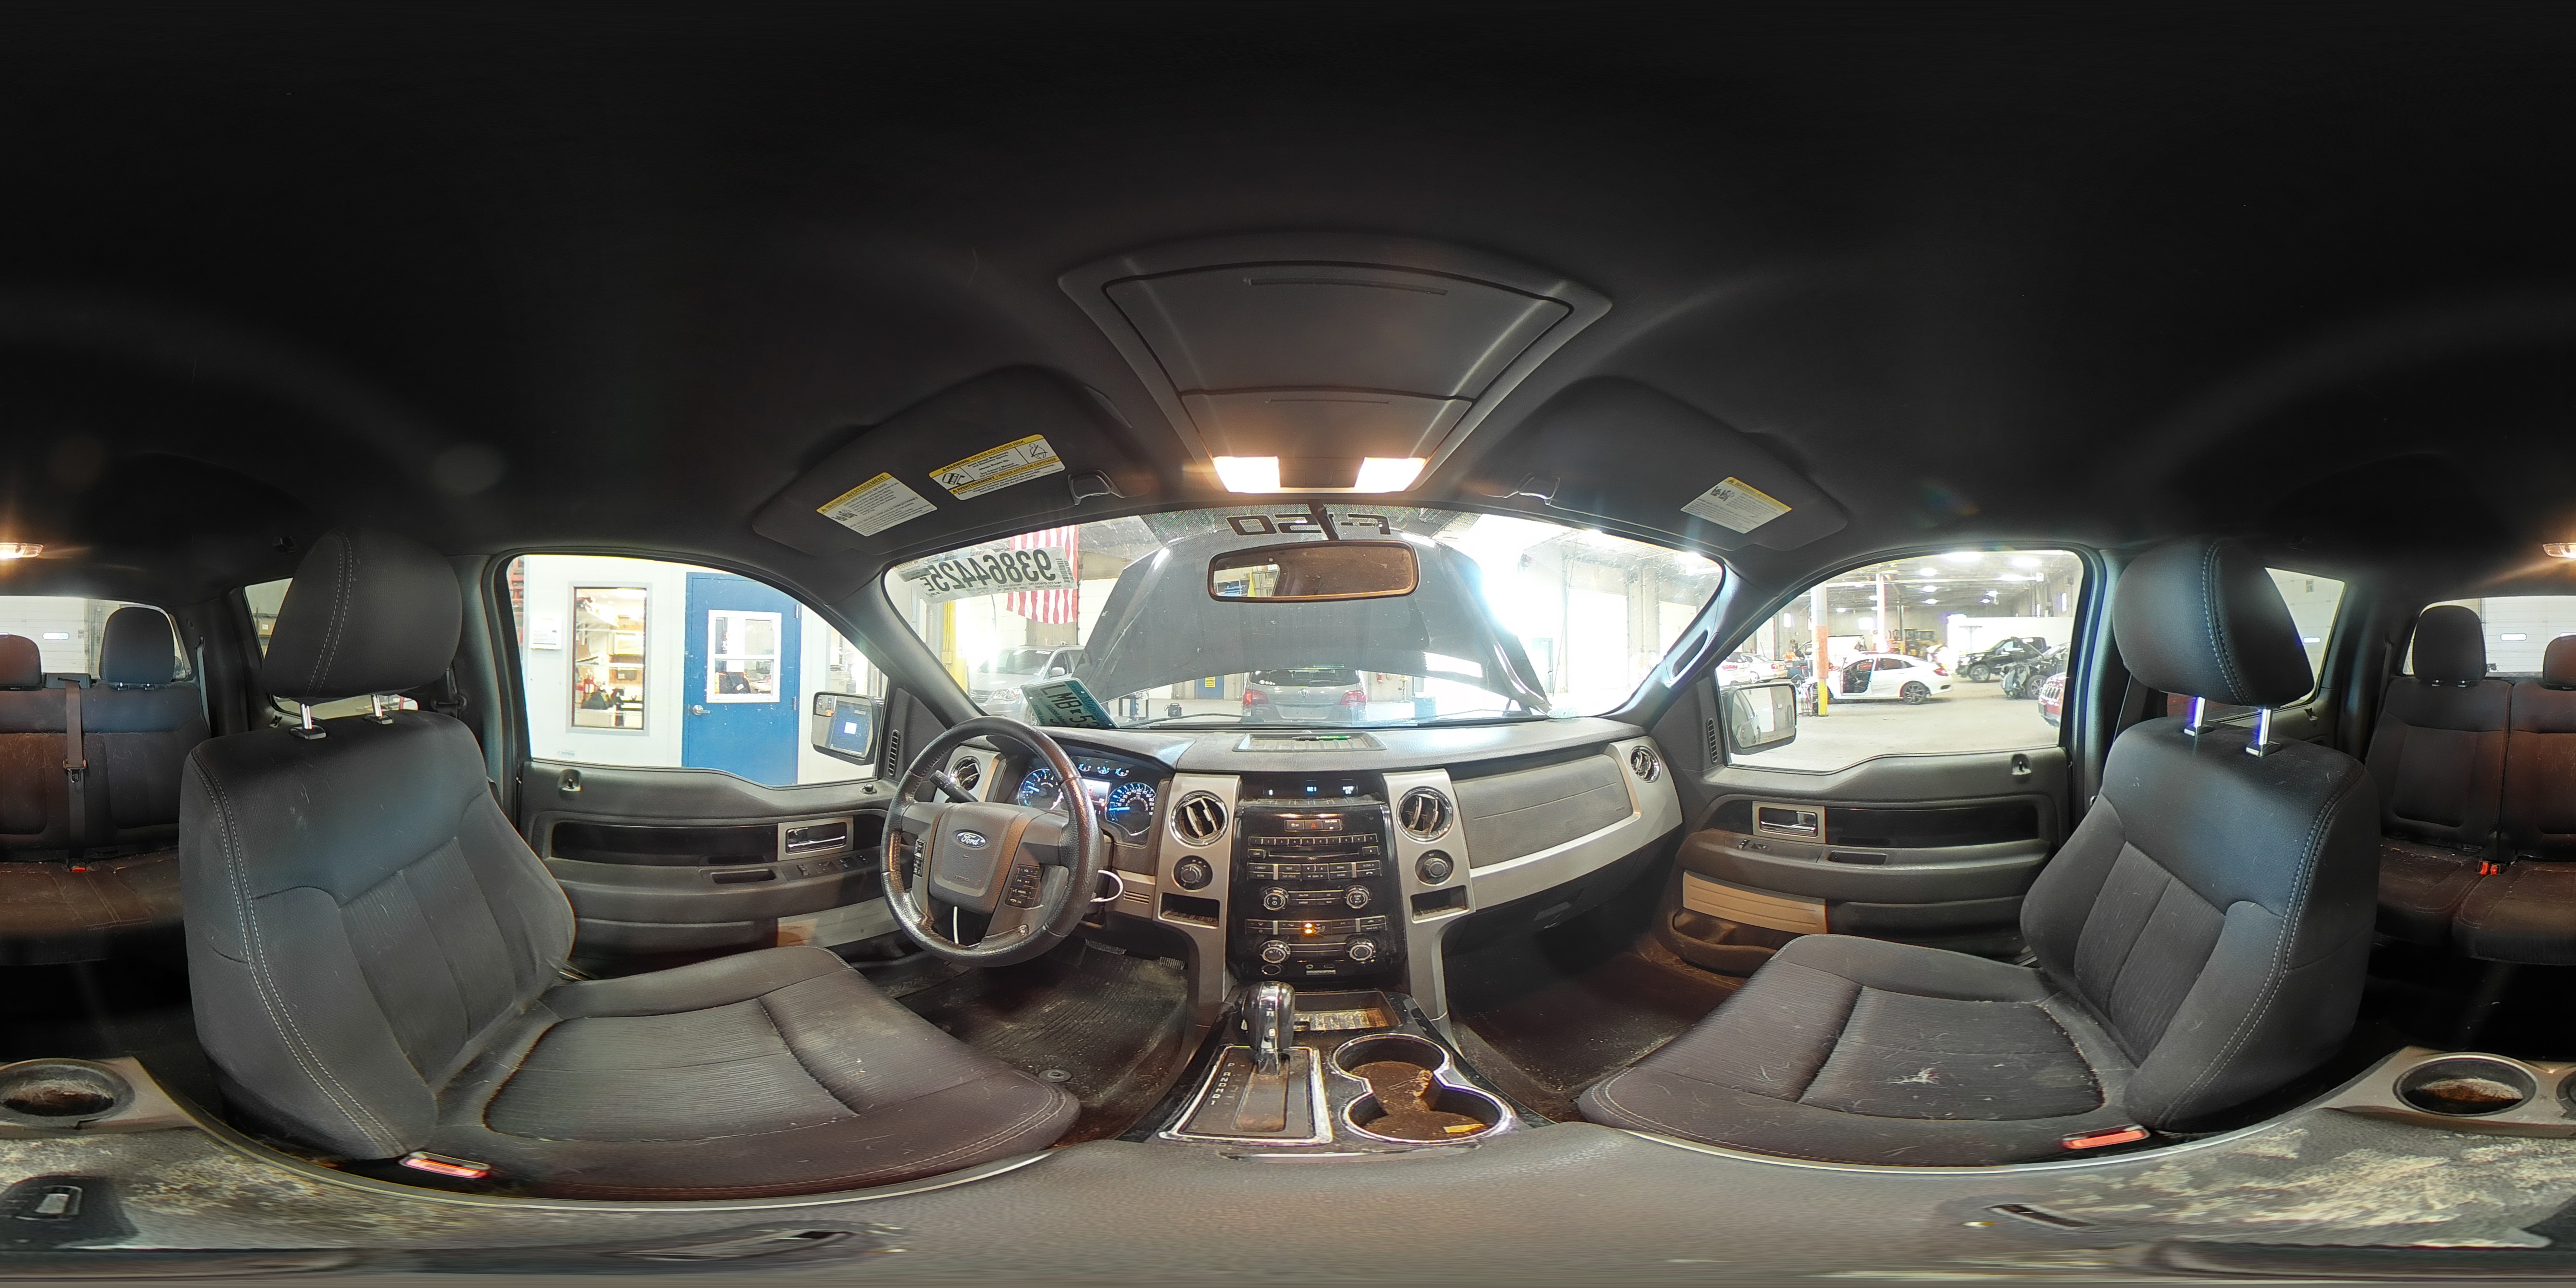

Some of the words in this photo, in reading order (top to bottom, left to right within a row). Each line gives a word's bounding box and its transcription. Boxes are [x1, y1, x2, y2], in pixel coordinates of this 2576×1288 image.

[987, 444, 1012, 454] ROLLOVER
[957, 476, 995, 491] AVERTISSEMENT
[999, 470, 1013, 478] RISQUE
[1034, 458, 1057, 467] CAPOTAGE
[846, 475, 886, 498] AVERTISSEMENT
[1039, 684, 1083, 709] LMB
[961, 834, 980, 845] Ford
